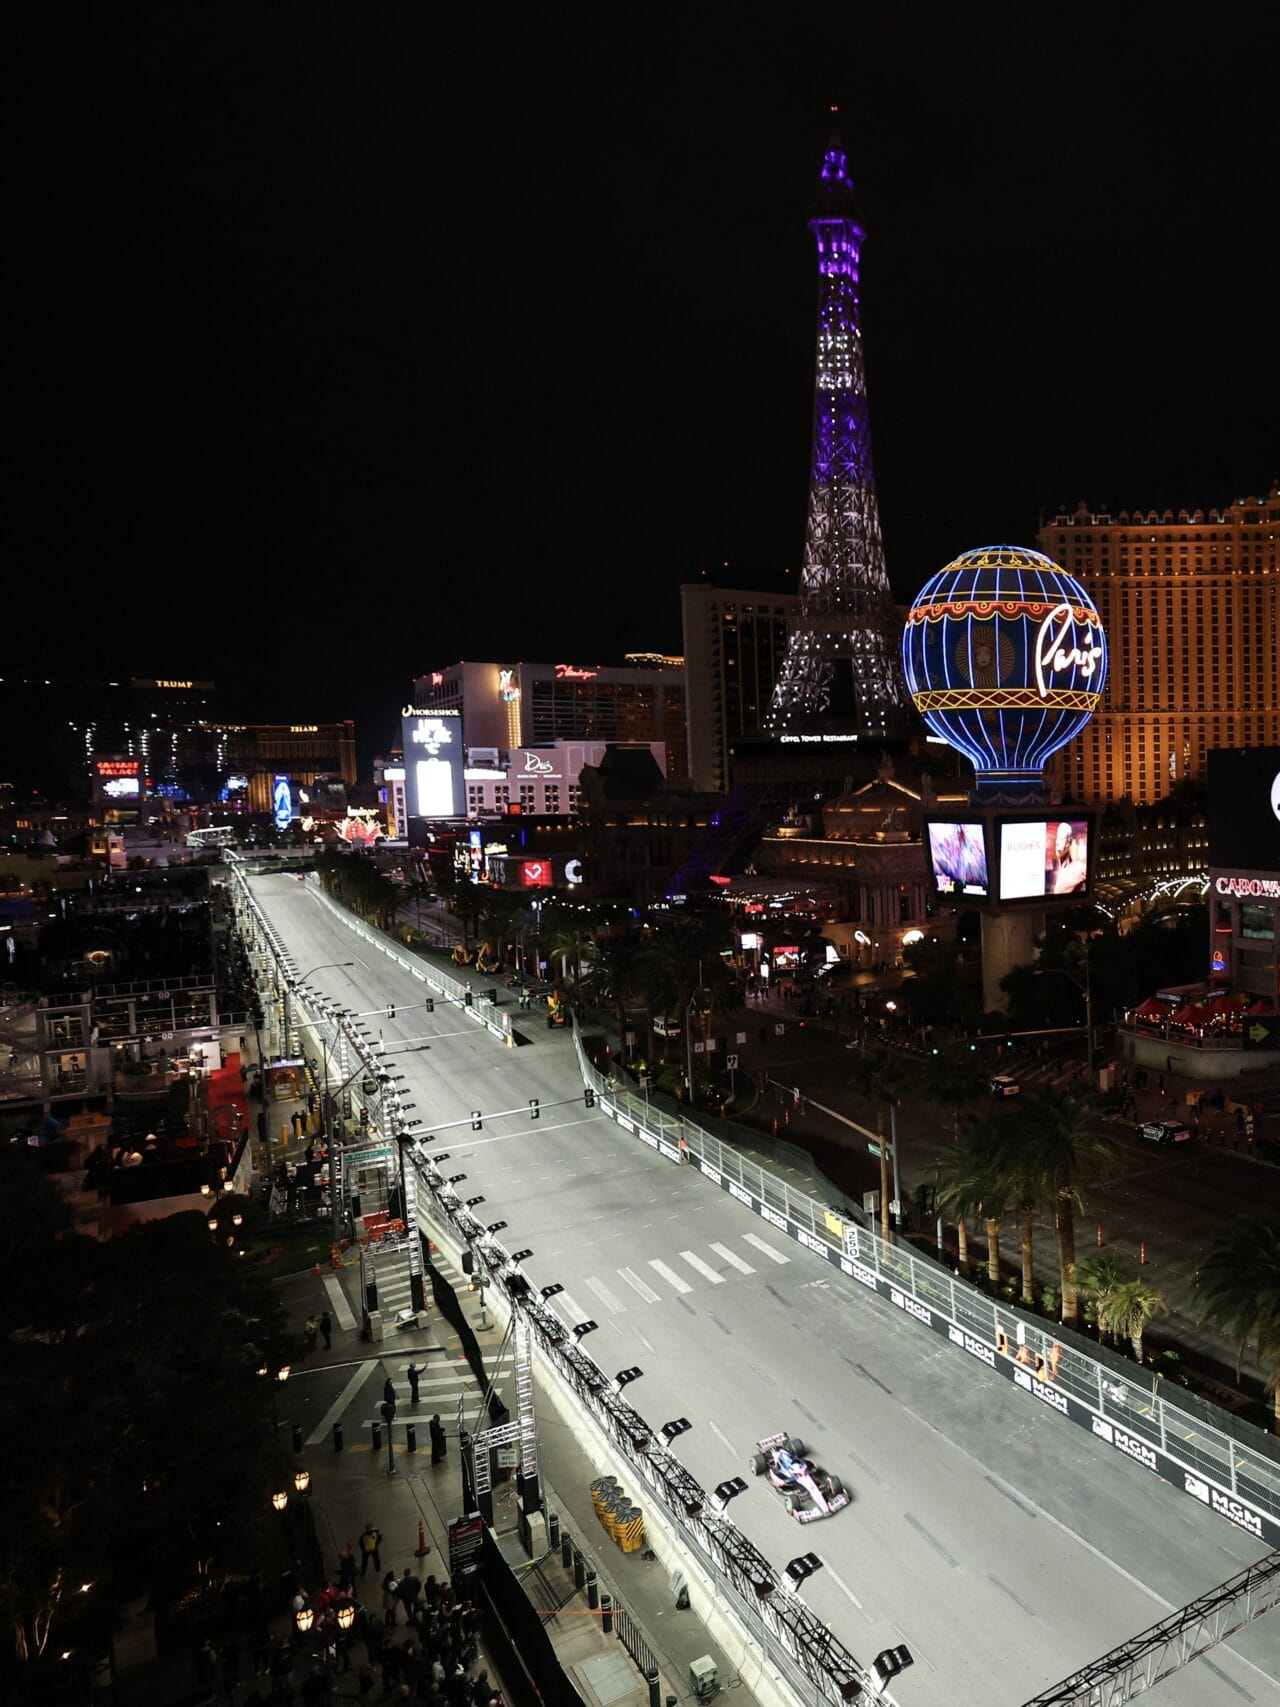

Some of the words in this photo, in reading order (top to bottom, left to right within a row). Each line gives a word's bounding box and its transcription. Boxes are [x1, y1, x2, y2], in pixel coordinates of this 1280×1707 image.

[1036, 603, 1102, 697] Paris
[156, 680, 193, 688] TRUMP
[412, 708, 461, 716] HORSESHOE
[1215, 877, 1263, 898] CABO
[808, 1235, 828, 1255] MGM
[848, 1231, 859, 1257] 250
[853, 1264, 877, 1285] MGM
[904, 1297, 931, 1320] MGM
[964, 1335, 995, 1366] MGM
[1032, 1378, 1067, 1409] MGM
[1114, 1429, 1156, 1464] MGM
[1115, 1440, 1158, 1471] REWARDS
[1212, 1489, 1262, 1530] MGM
[1212, 1502, 1264, 1538] REWARDS
